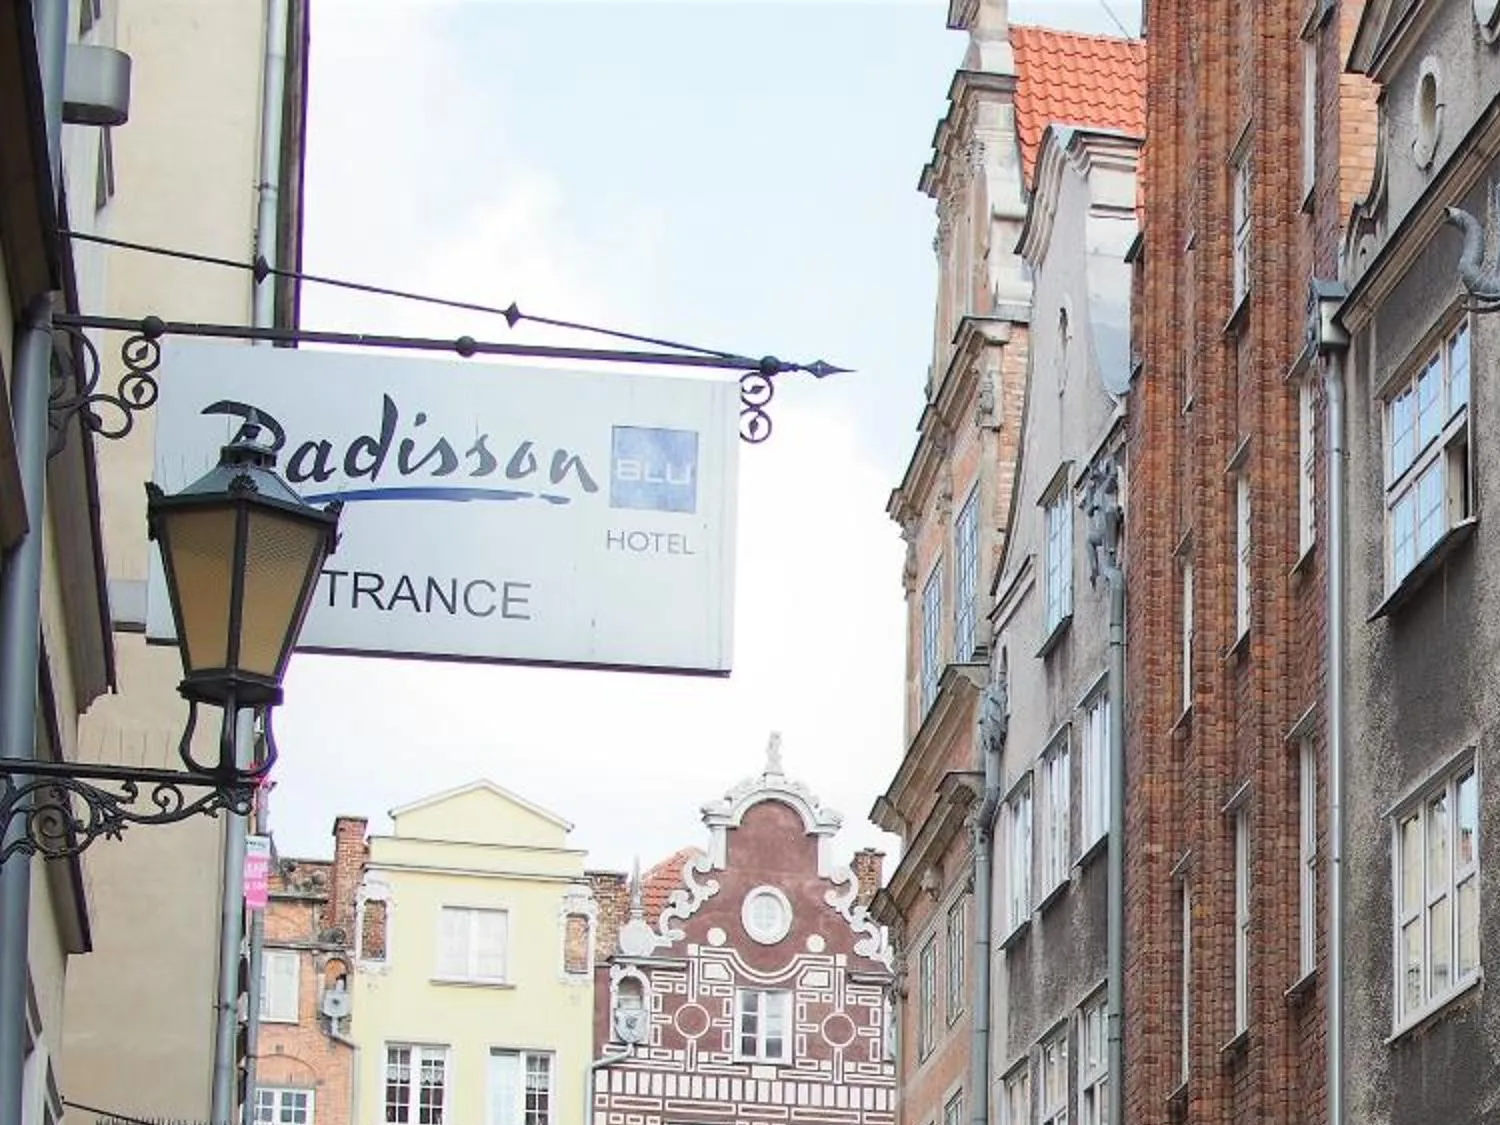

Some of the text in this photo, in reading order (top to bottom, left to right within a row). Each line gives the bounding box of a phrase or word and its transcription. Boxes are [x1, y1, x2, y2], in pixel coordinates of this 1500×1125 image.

[201, 392, 599, 493] Radisson
[617, 457, 695, 485] BLU
[606, 529, 695, 556] HOTEL
[320, 569, 532, 620] TRANCE
